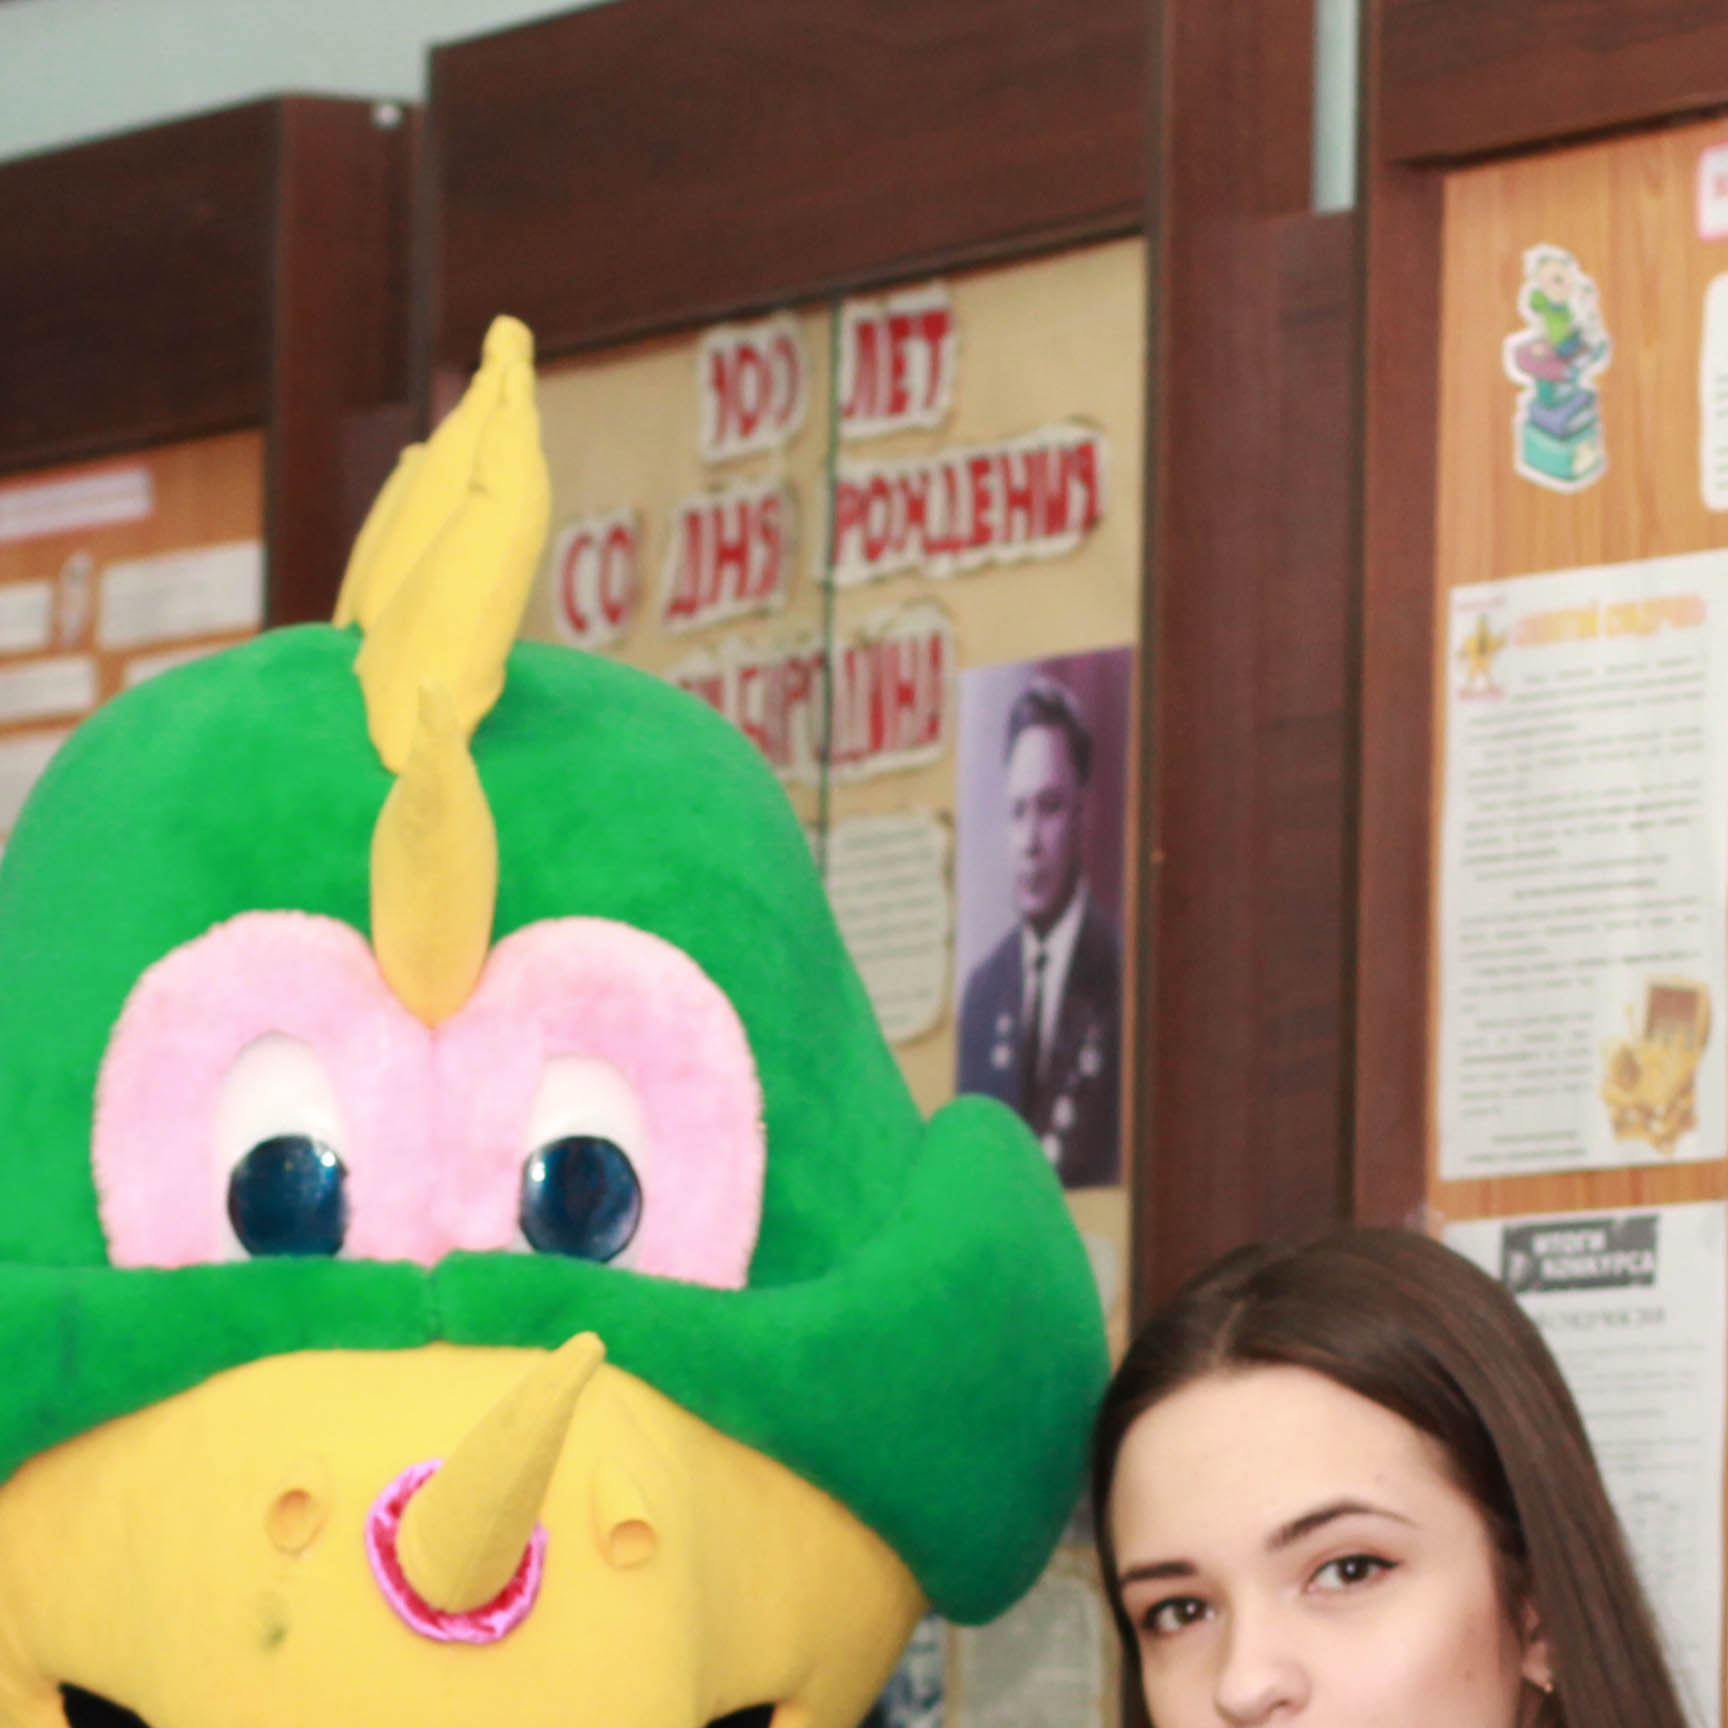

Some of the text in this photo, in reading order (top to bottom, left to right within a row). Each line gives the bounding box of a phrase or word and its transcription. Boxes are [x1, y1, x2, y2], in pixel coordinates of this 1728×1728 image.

[712, 310, 952, 446] 100 ЛЕТ
[561, 441, 1101, 634] СО ДНЯ РОЖДЕНИЯ
[1541, 1250, 1654, 1280] КОНКУРСА
